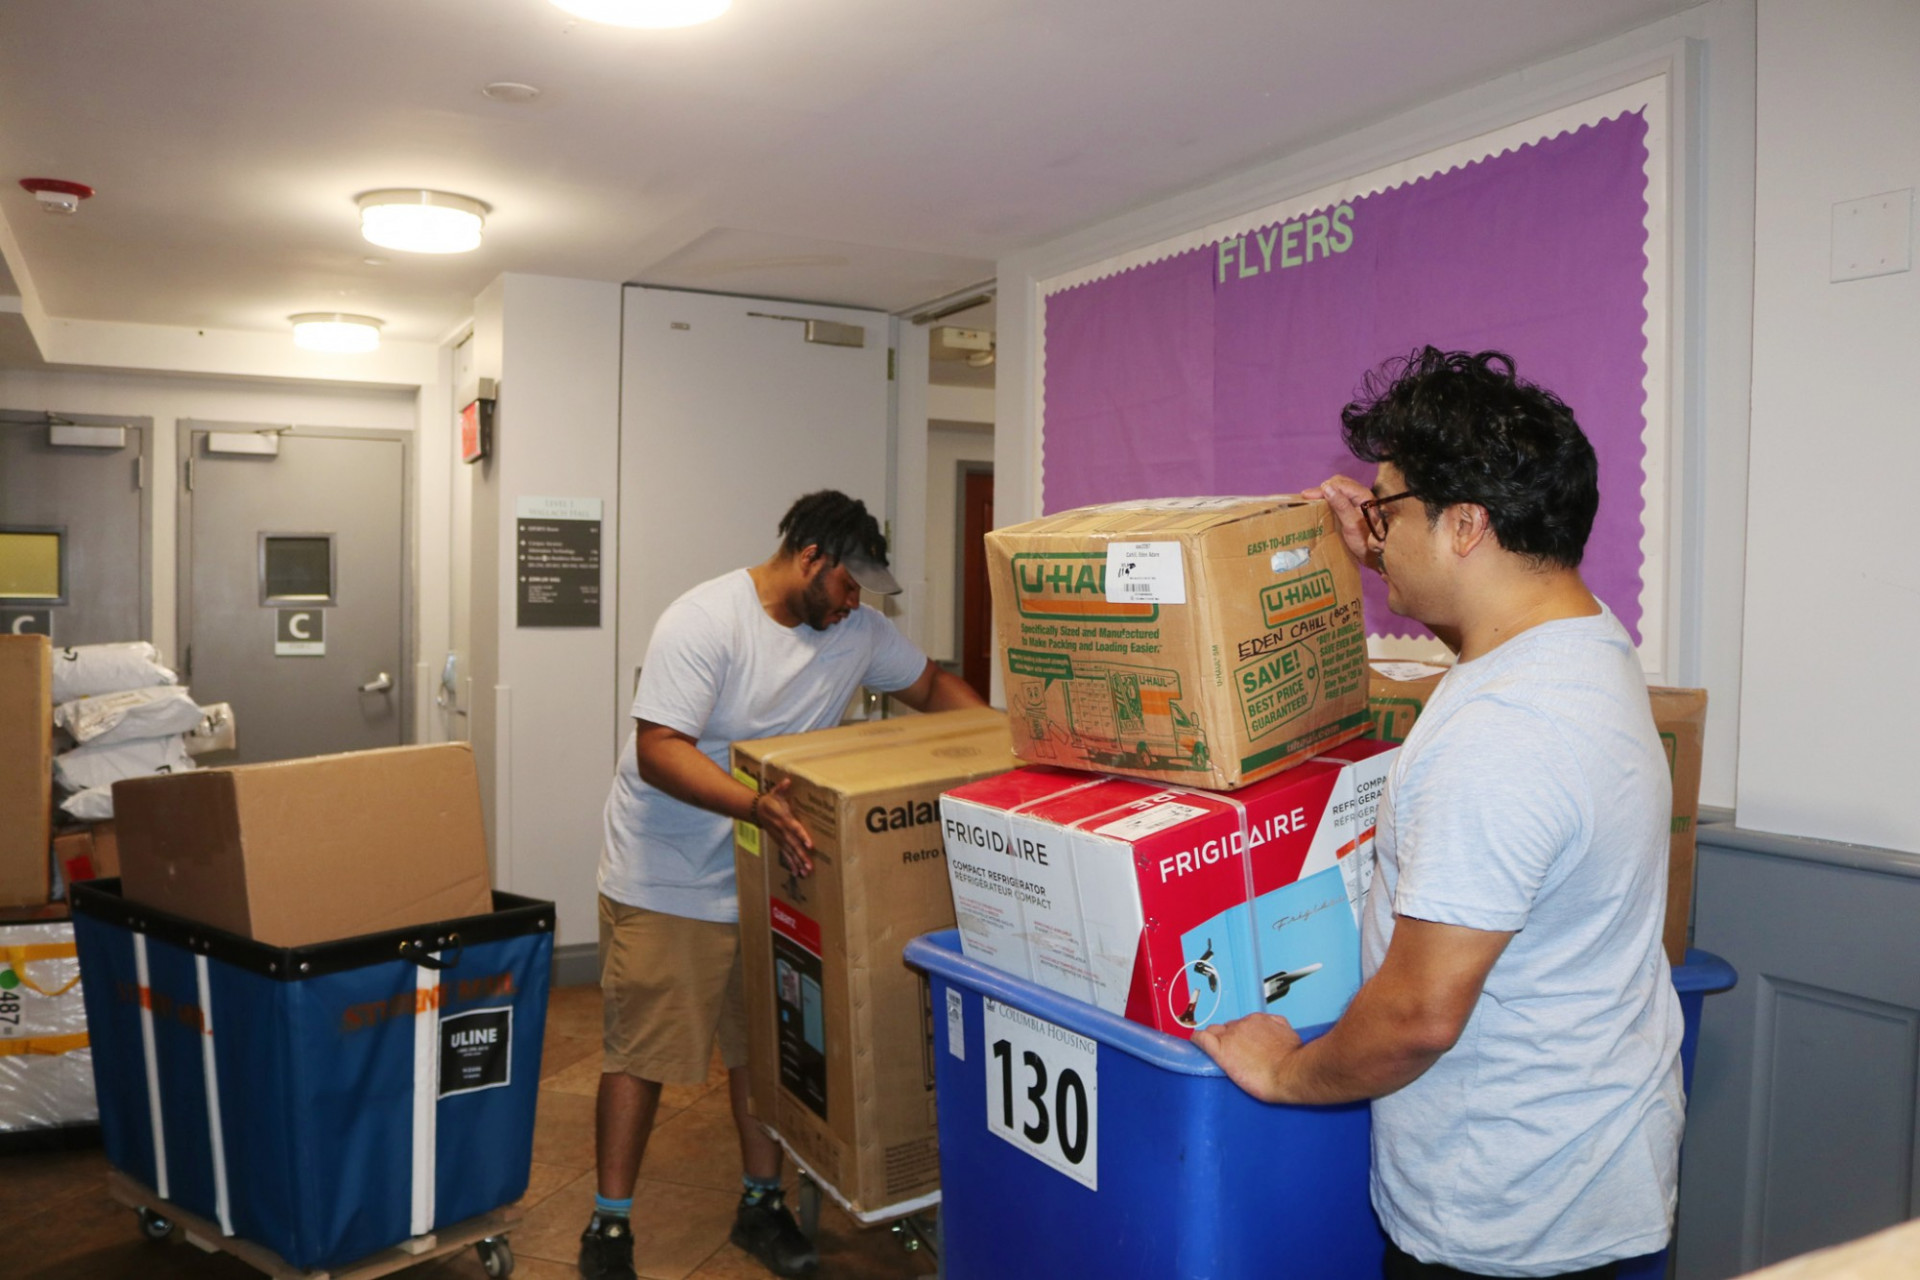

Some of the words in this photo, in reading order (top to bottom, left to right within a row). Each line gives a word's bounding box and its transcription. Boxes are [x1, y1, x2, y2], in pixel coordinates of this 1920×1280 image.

[1218, 205, 1354, 283] FLYERS
[1019, 564, 1106, 594] U-HA
[1266, 576, 1331, 612] U-HAUL
[289, 613, 310, 639] C
[1021, 622, 1059, 636] Specifically
[1060, 625, 1080, 637] Sized
[1081, 627, 1096, 637] and
[1099, 627, 1160, 639] Manufactured
[1238, 628, 1283, 658] EDEN
[1290, 615, 1326, 639] CAHILL
[1021, 636, 1028, 646] to
[1029, 637, 1047, 647] Make
[1048, 638, 1077, 652] Packing
[1078, 639, 1093, 651] and
[1095, 640, 1128, 653] Loading
[1242, 648, 1301, 694] SAVE!
[1248, 694, 1274, 718] BEST
[1277, 678, 1304, 703] PRICE
[1356, 775, 1387, 794] COMPA
[865, 800, 941, 833] Gala
[903, 848, 939, 864] Retro
[946, 819, 1049, 867] FRIGIDAIRE
[1158, 807, 1307, 884] FRIGIDAIRE
[952, 859, 987, 878] COMPACT
[987, 870, 1046, 896] REFRIGERATOR
[1014, 889, 1052, 910] COMPACT
[451, 1027, 498, 1048] ULINE
[998, 1003, 1046, 1035] COLUMBIA
[1047, 1020, 1096, 1056] HOUSING
[992, 1039, 1089, 1164] 130
